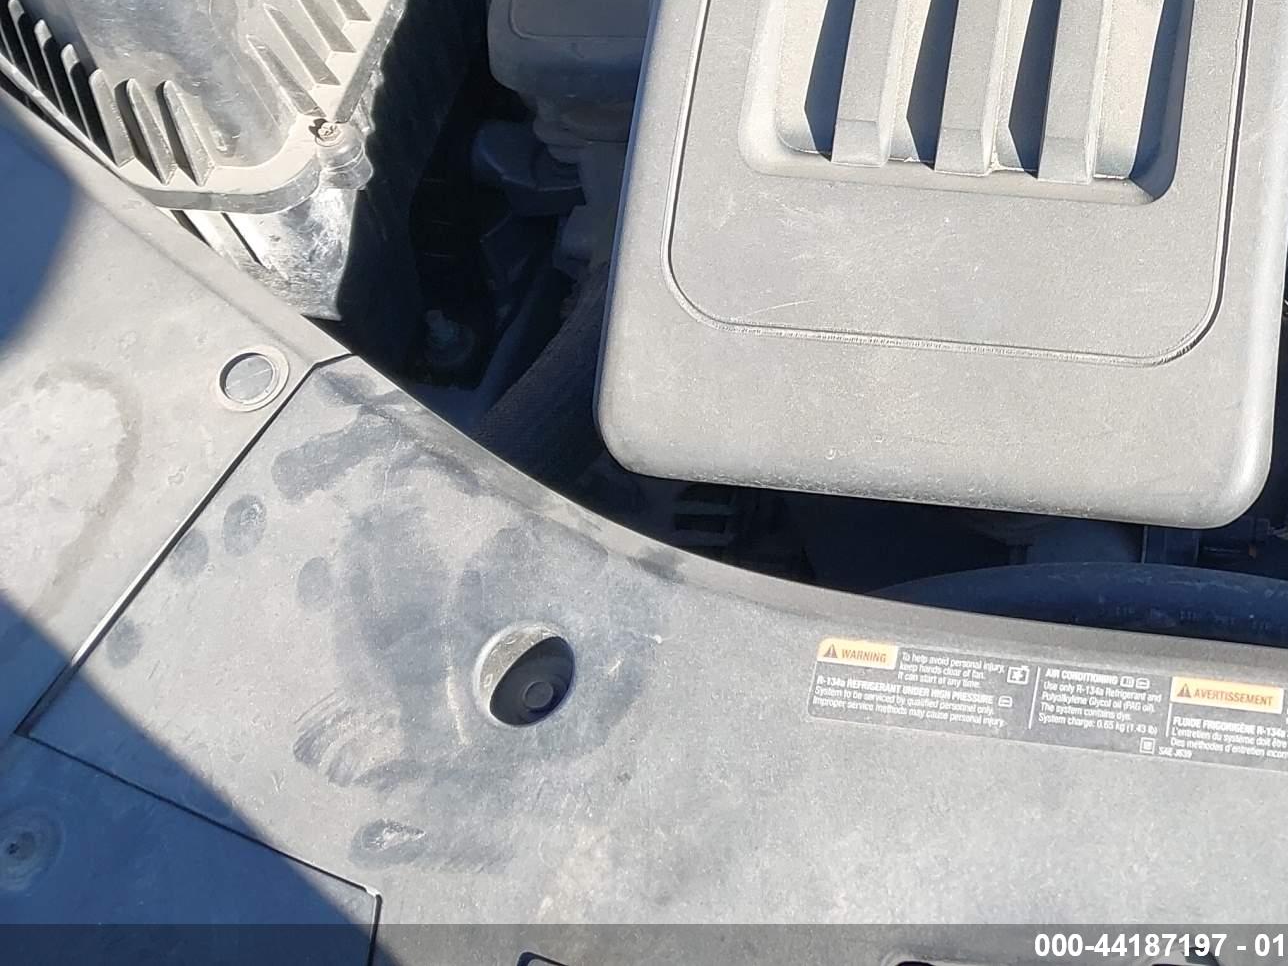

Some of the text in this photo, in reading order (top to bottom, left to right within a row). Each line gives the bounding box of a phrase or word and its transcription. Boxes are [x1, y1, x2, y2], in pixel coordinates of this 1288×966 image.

[841, 648, 886, 663] WARNING
[902, 652, 910, 662] To
[911, 653, 927, 664] help
[929, 655, 949, 666] avoid
[950, 657, 981, 670] personal
[1045, 667, 1118, 685] AIR CONDITIONING
[816, 675, 993, 704] R-134a REFRIGERANT UNDER HIGH PRESSURE
[1044, 680, 1161, 703] Use only R-134a Refrigerant and
[1193, 687, 1272, 706] AVERTISSEMENT
[1041, 701, 1130, 721] The system contains dye.
